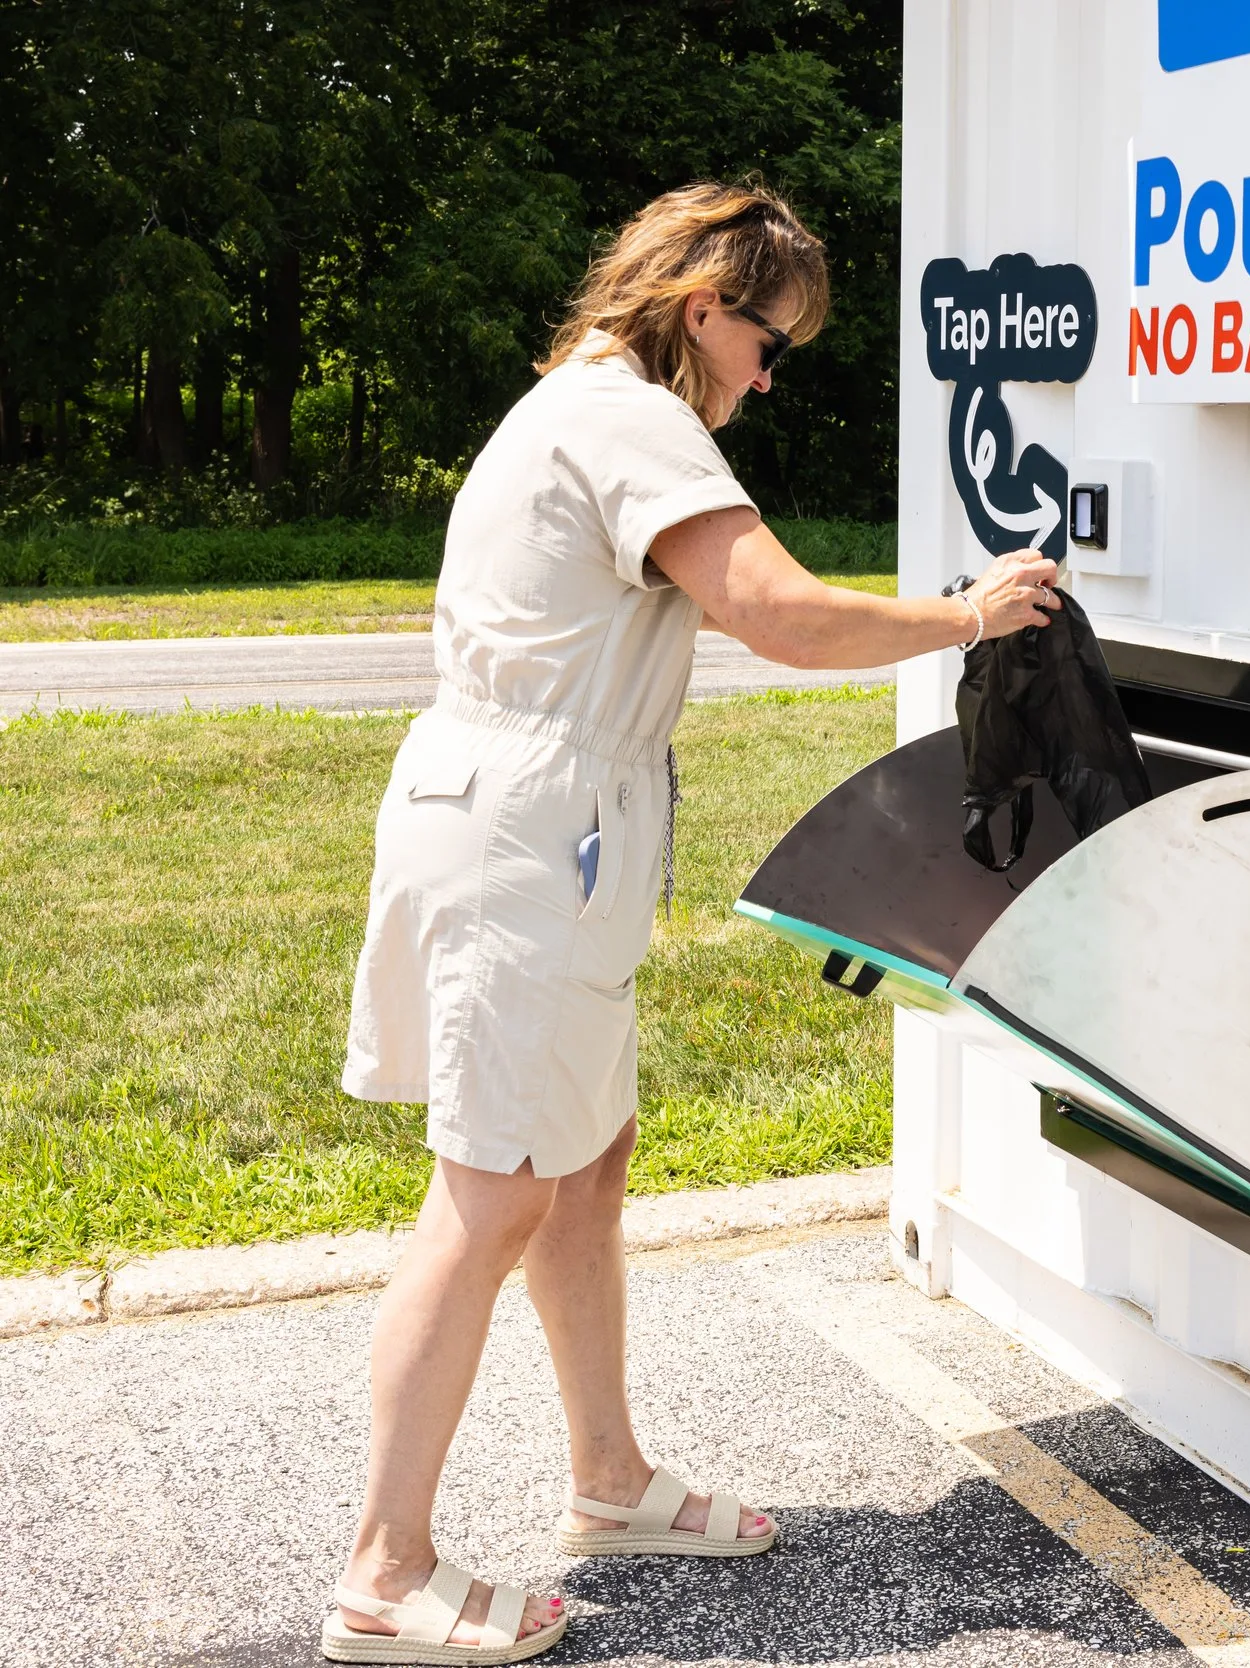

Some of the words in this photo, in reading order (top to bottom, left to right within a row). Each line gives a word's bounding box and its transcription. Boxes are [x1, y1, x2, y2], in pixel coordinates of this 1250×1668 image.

[933, 296, 990, 365] Tap
[999, 293, 1080, 350] Here
[1128, 303, 1198, 376] NO
